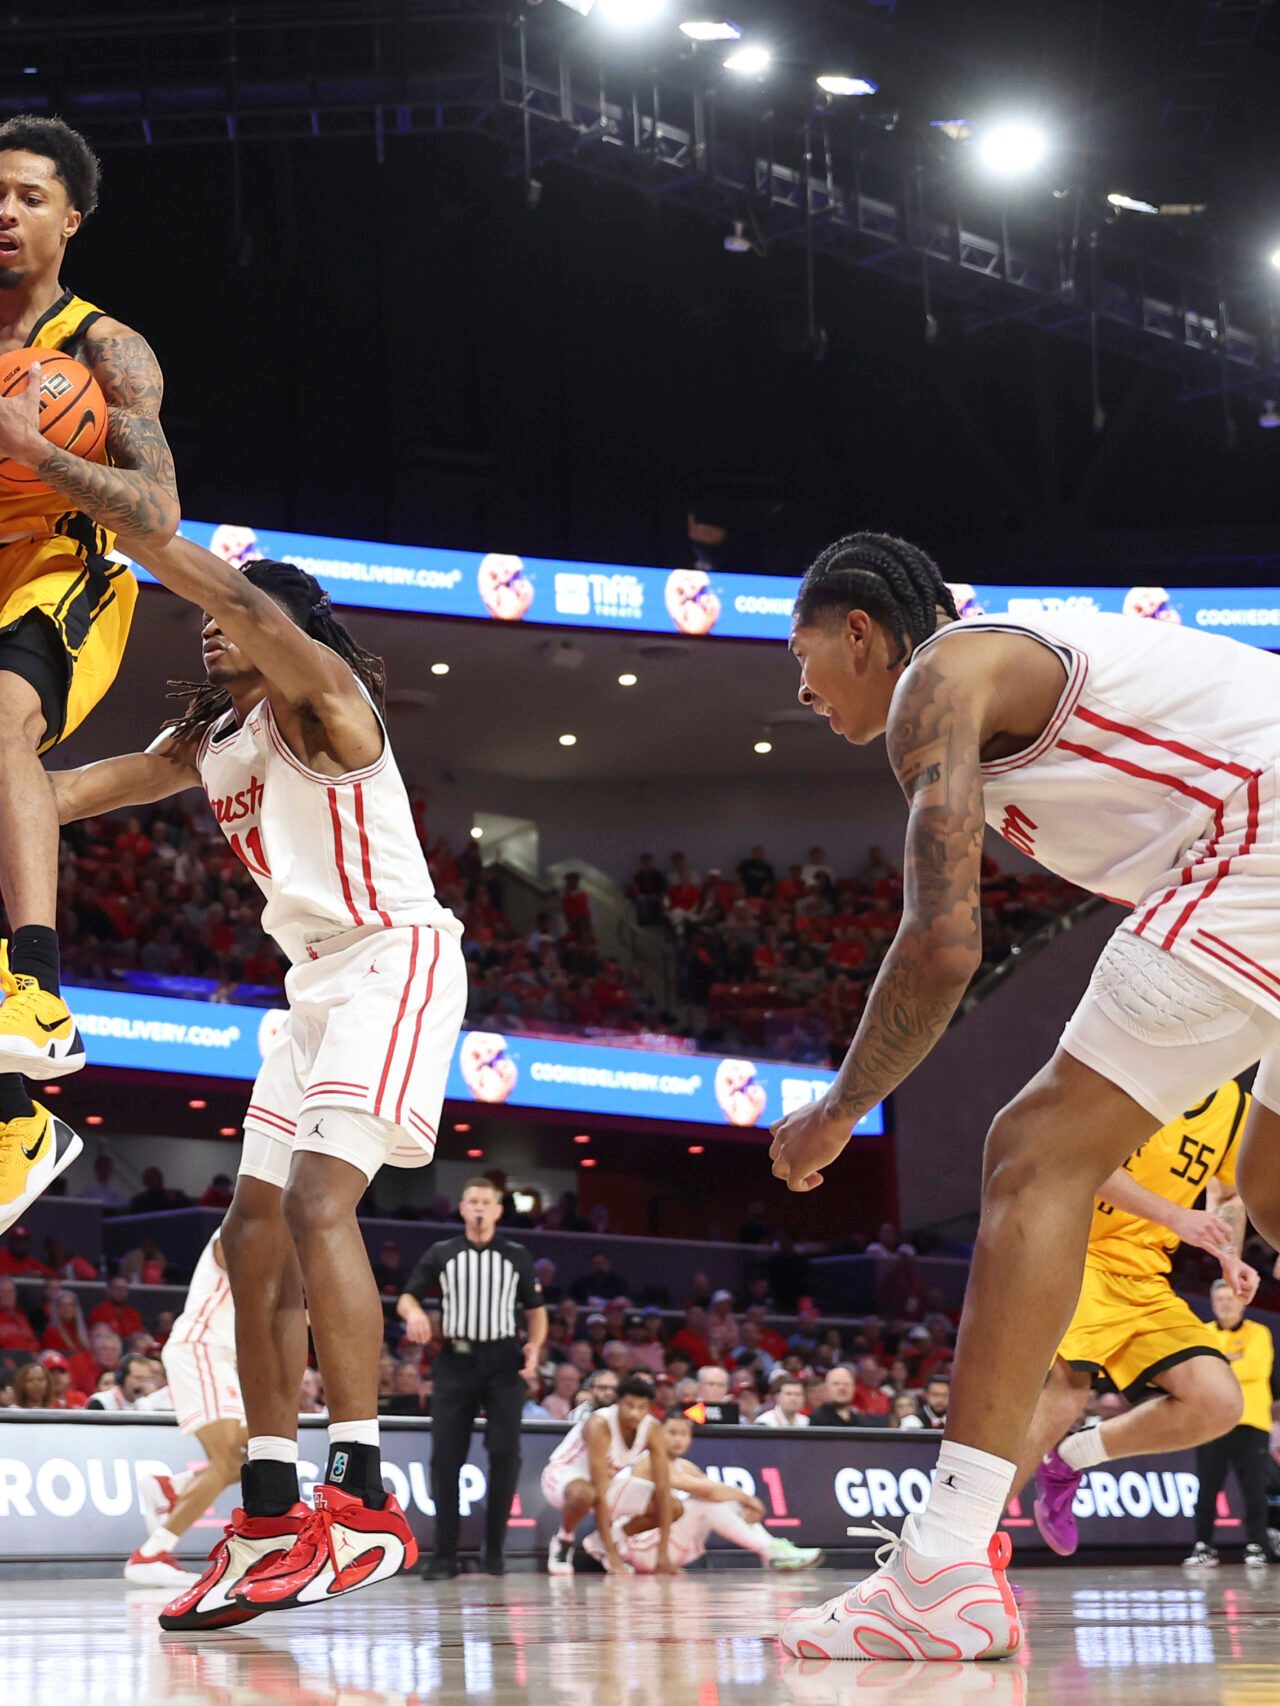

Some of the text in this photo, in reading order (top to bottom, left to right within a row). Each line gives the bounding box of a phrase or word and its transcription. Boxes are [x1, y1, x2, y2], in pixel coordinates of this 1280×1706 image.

[735, 595, 794, 616] COOKIE
[1196, 609, 1280, 627] COOKIEDE
[1170, 1134, 1216, 1186] 55
[761, 1467, 801, 1527] 1
[834, 1467, 937, 1518] GRO
[1071, 1471, 1200, 1518] GROUP
